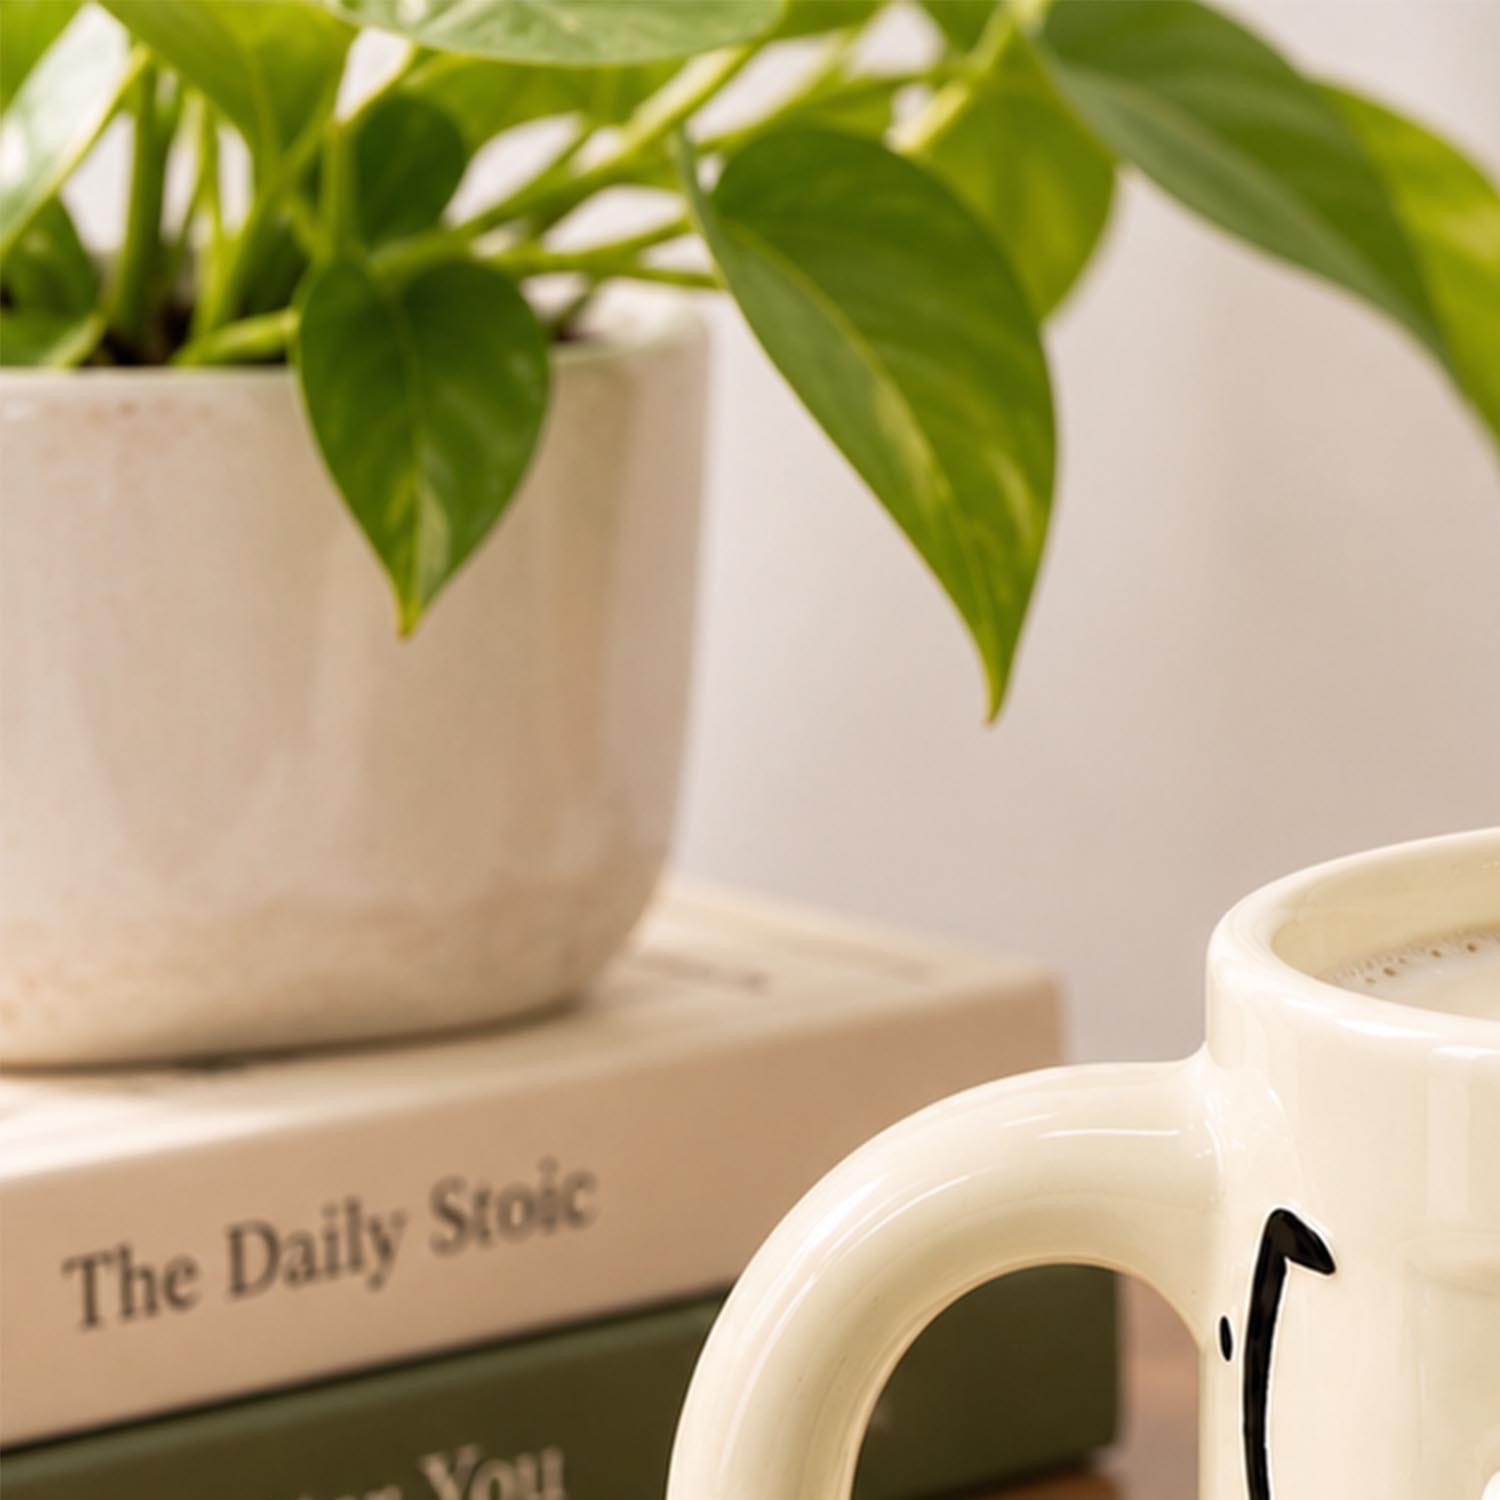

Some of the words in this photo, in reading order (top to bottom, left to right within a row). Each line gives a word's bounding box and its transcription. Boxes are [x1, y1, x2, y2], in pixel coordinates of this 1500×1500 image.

[62, 1242, 199, 1332] The
[223, 1196, 408, 1301] Daily
[428, 1156, 598, 1257] Stoic
